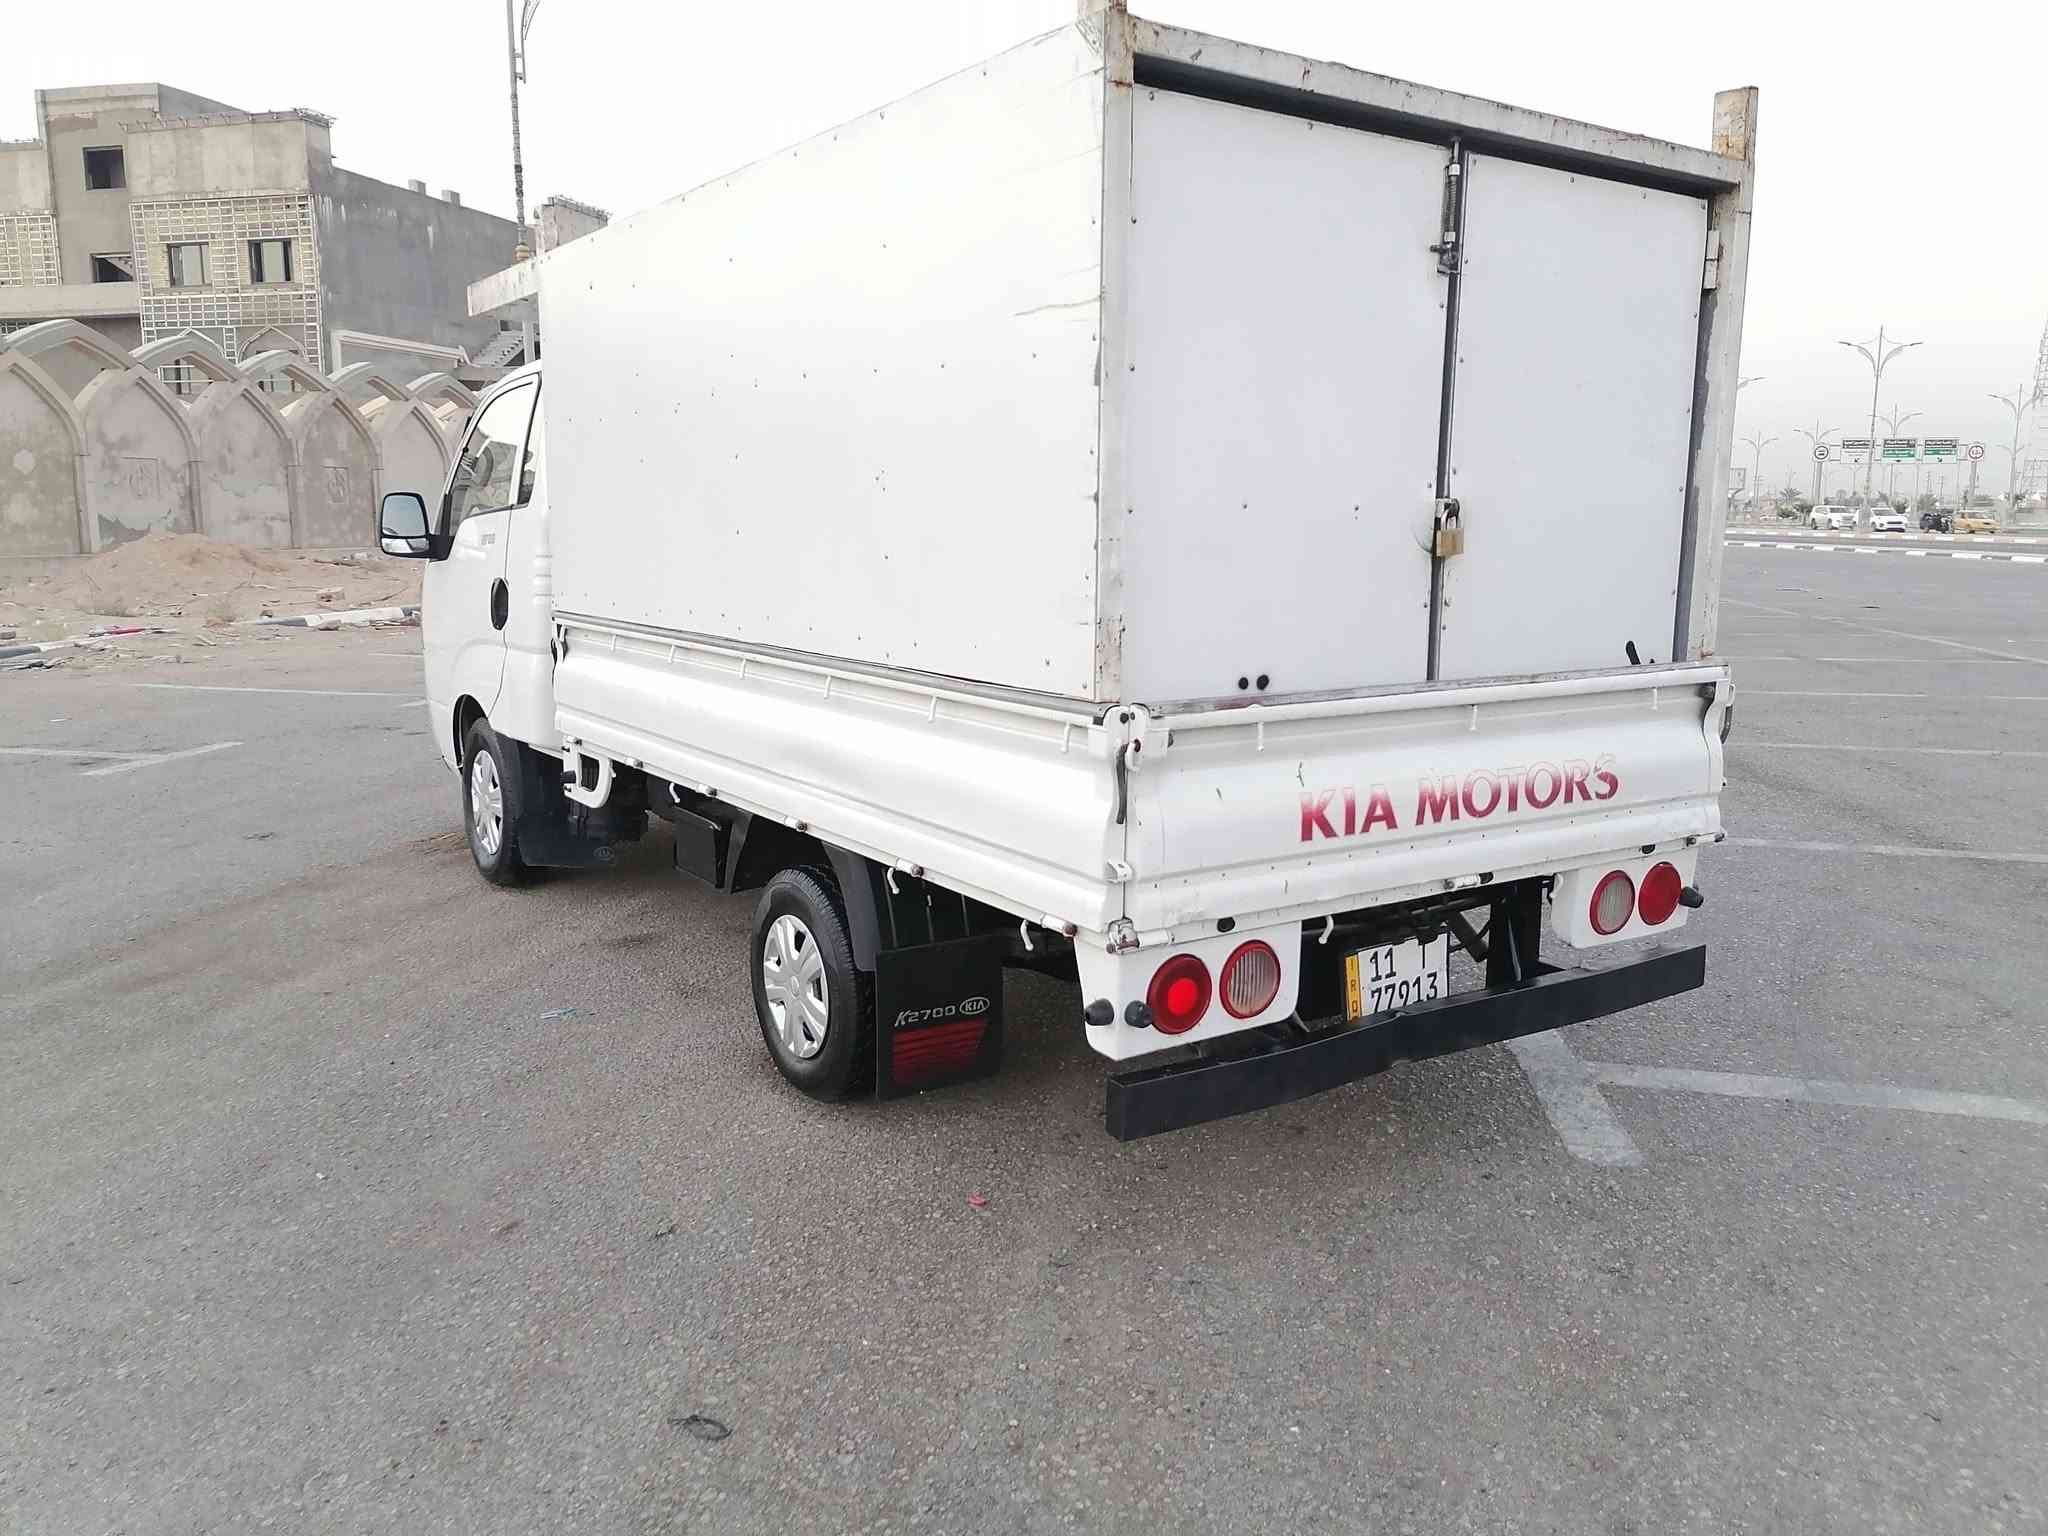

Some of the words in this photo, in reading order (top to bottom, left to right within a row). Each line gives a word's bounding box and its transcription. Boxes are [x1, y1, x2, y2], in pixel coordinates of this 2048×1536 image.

[1301, 783, 1398, 842] KIA
[1416, 753, 1619, 826] MOTORS
[1369, 947, 1396, 982] 11
[1371, 971, 1437, 1014] 77913
[894, 1005, 956, 1027] K2700
[965, 1000, 984, 1012] KIA
